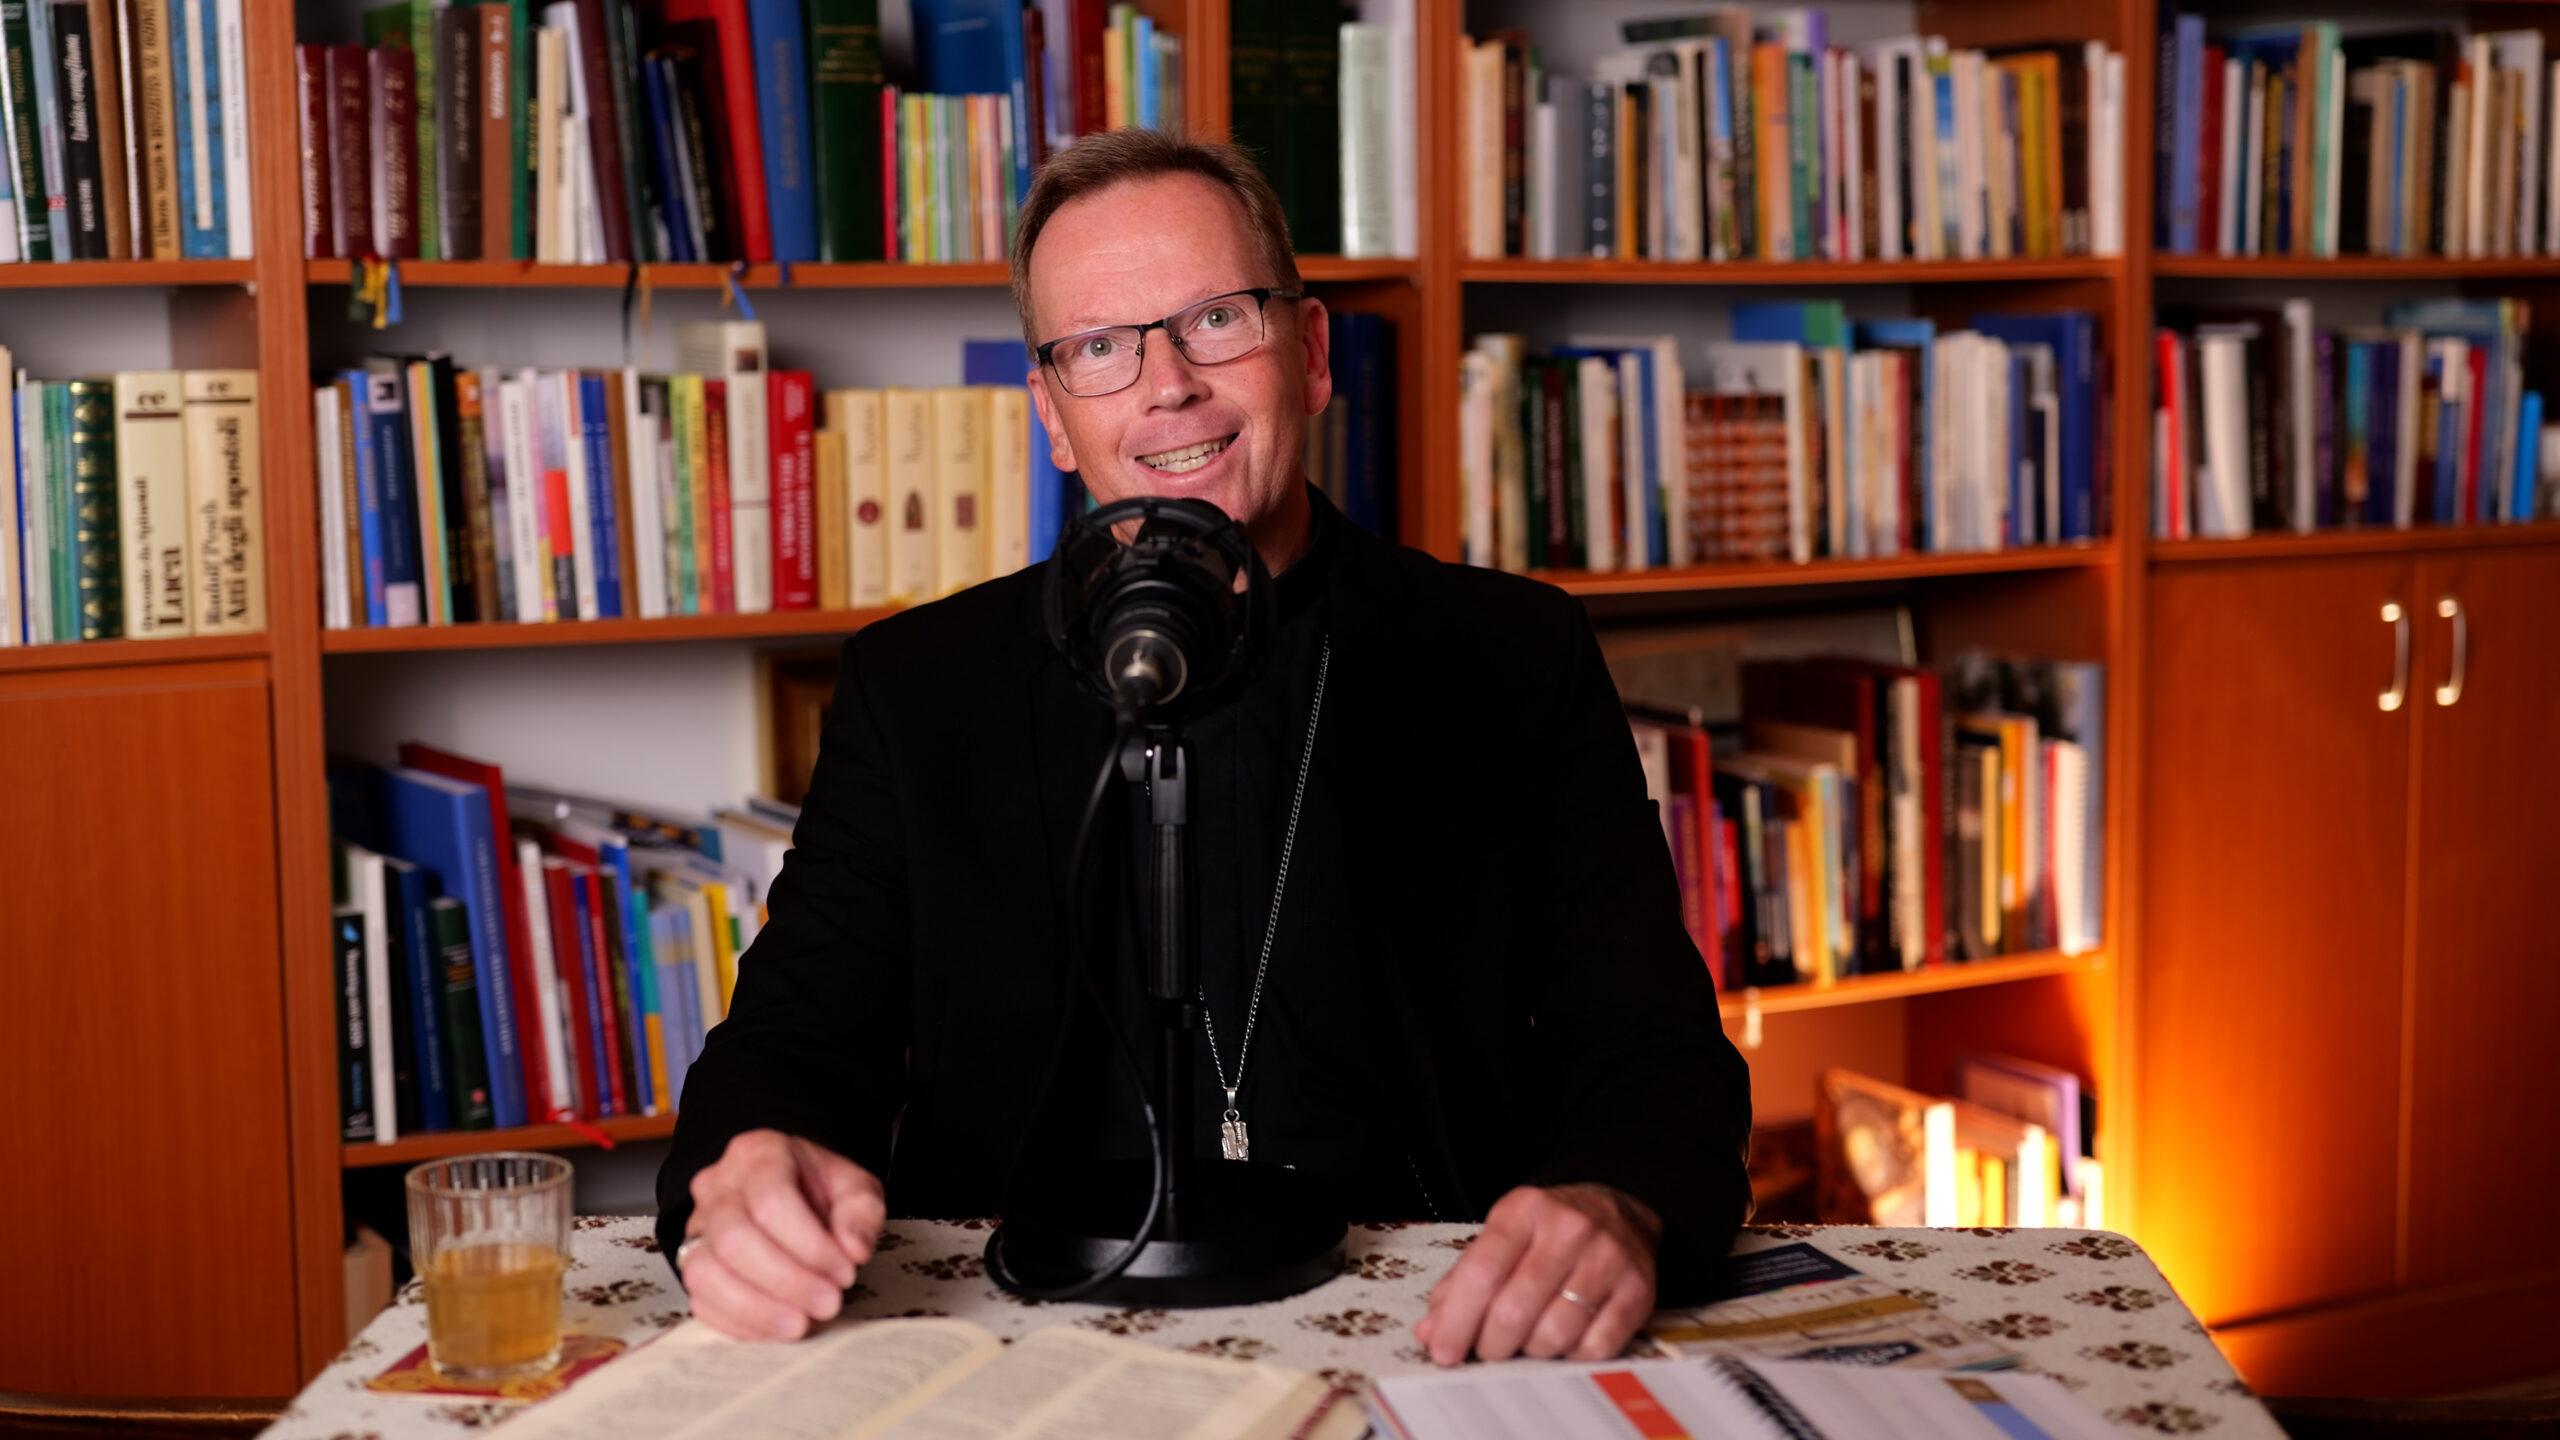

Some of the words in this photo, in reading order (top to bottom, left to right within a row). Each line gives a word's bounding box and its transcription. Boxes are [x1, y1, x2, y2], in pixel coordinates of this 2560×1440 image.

[216, 417, 249, 510] apostoli
[200, 500, 219, 556] Pesch
[223, 516, 248, 572] degli
[157, 547, 185, 627] Luca
[203, 561, 222, 625] Rudolf
[226, 579, 249, 623] Atti
